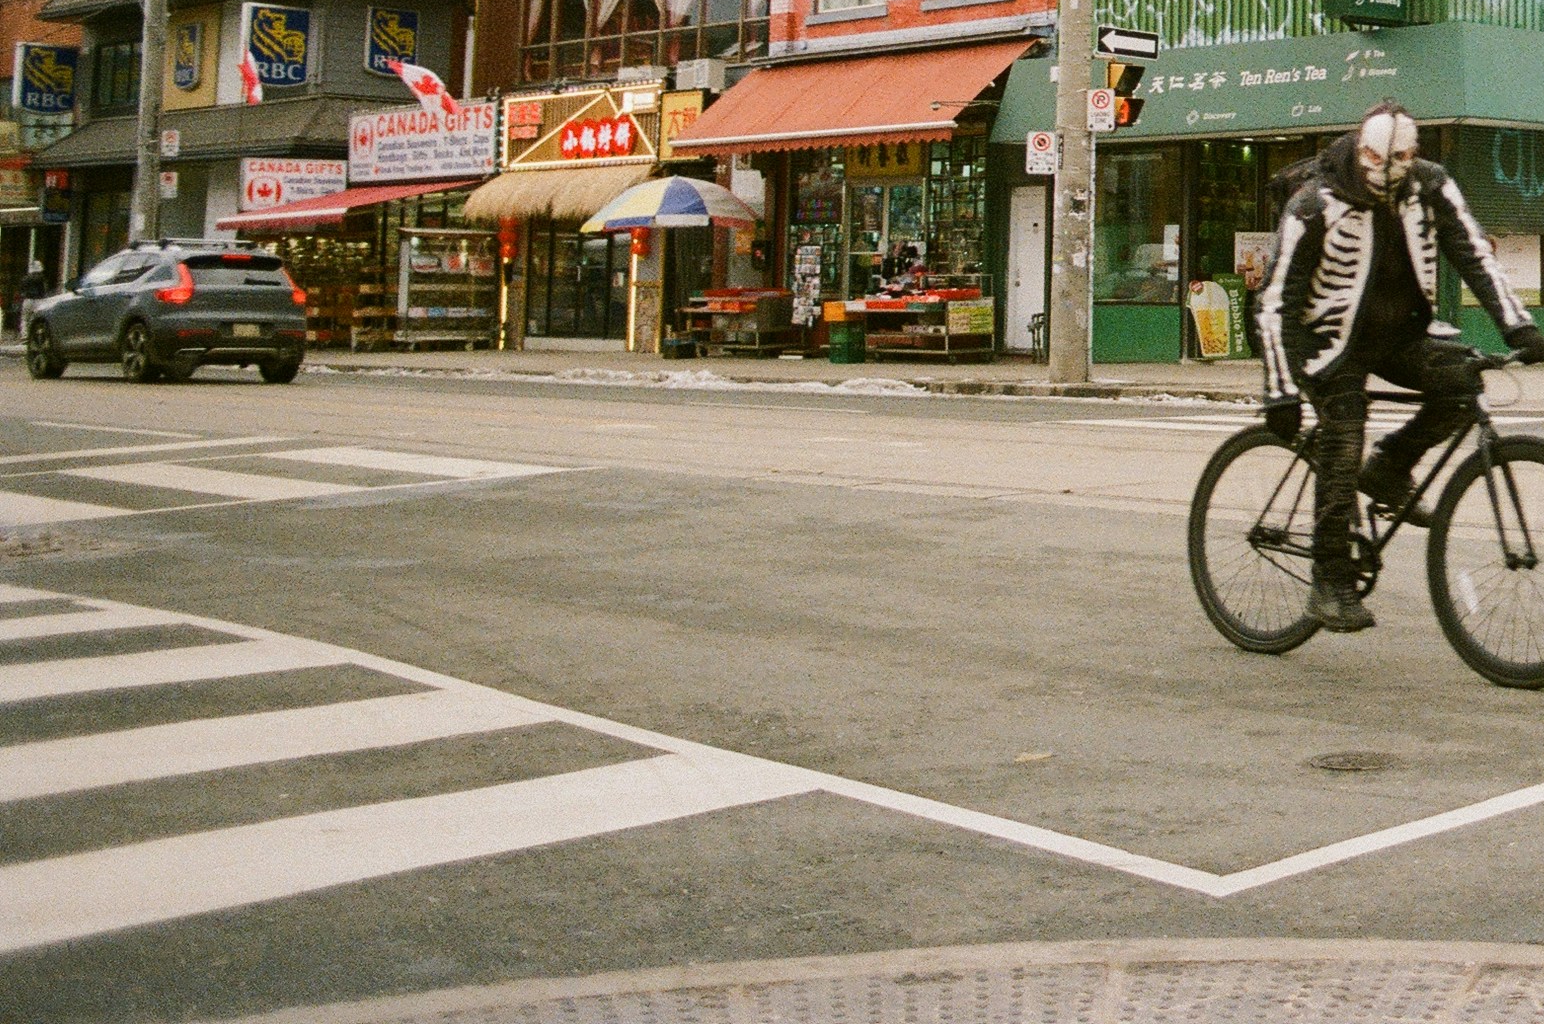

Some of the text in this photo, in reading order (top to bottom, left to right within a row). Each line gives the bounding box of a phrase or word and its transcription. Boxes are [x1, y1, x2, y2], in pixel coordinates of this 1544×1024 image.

[256, 62, 302, 80] RBC
[1148, 65, 1327, 94] 天仁茗茶 Ten Ren's Tea
[26, 91, 71, 108] RBC
[376, 110, 440, 138] CANADA
[445, 104, 493, 132] GIFTS
[248, 161, 301, 173] CANADA
[305, 163, 343, 175] GIFTS
[1228, 289, 1241, 332] Bubble
